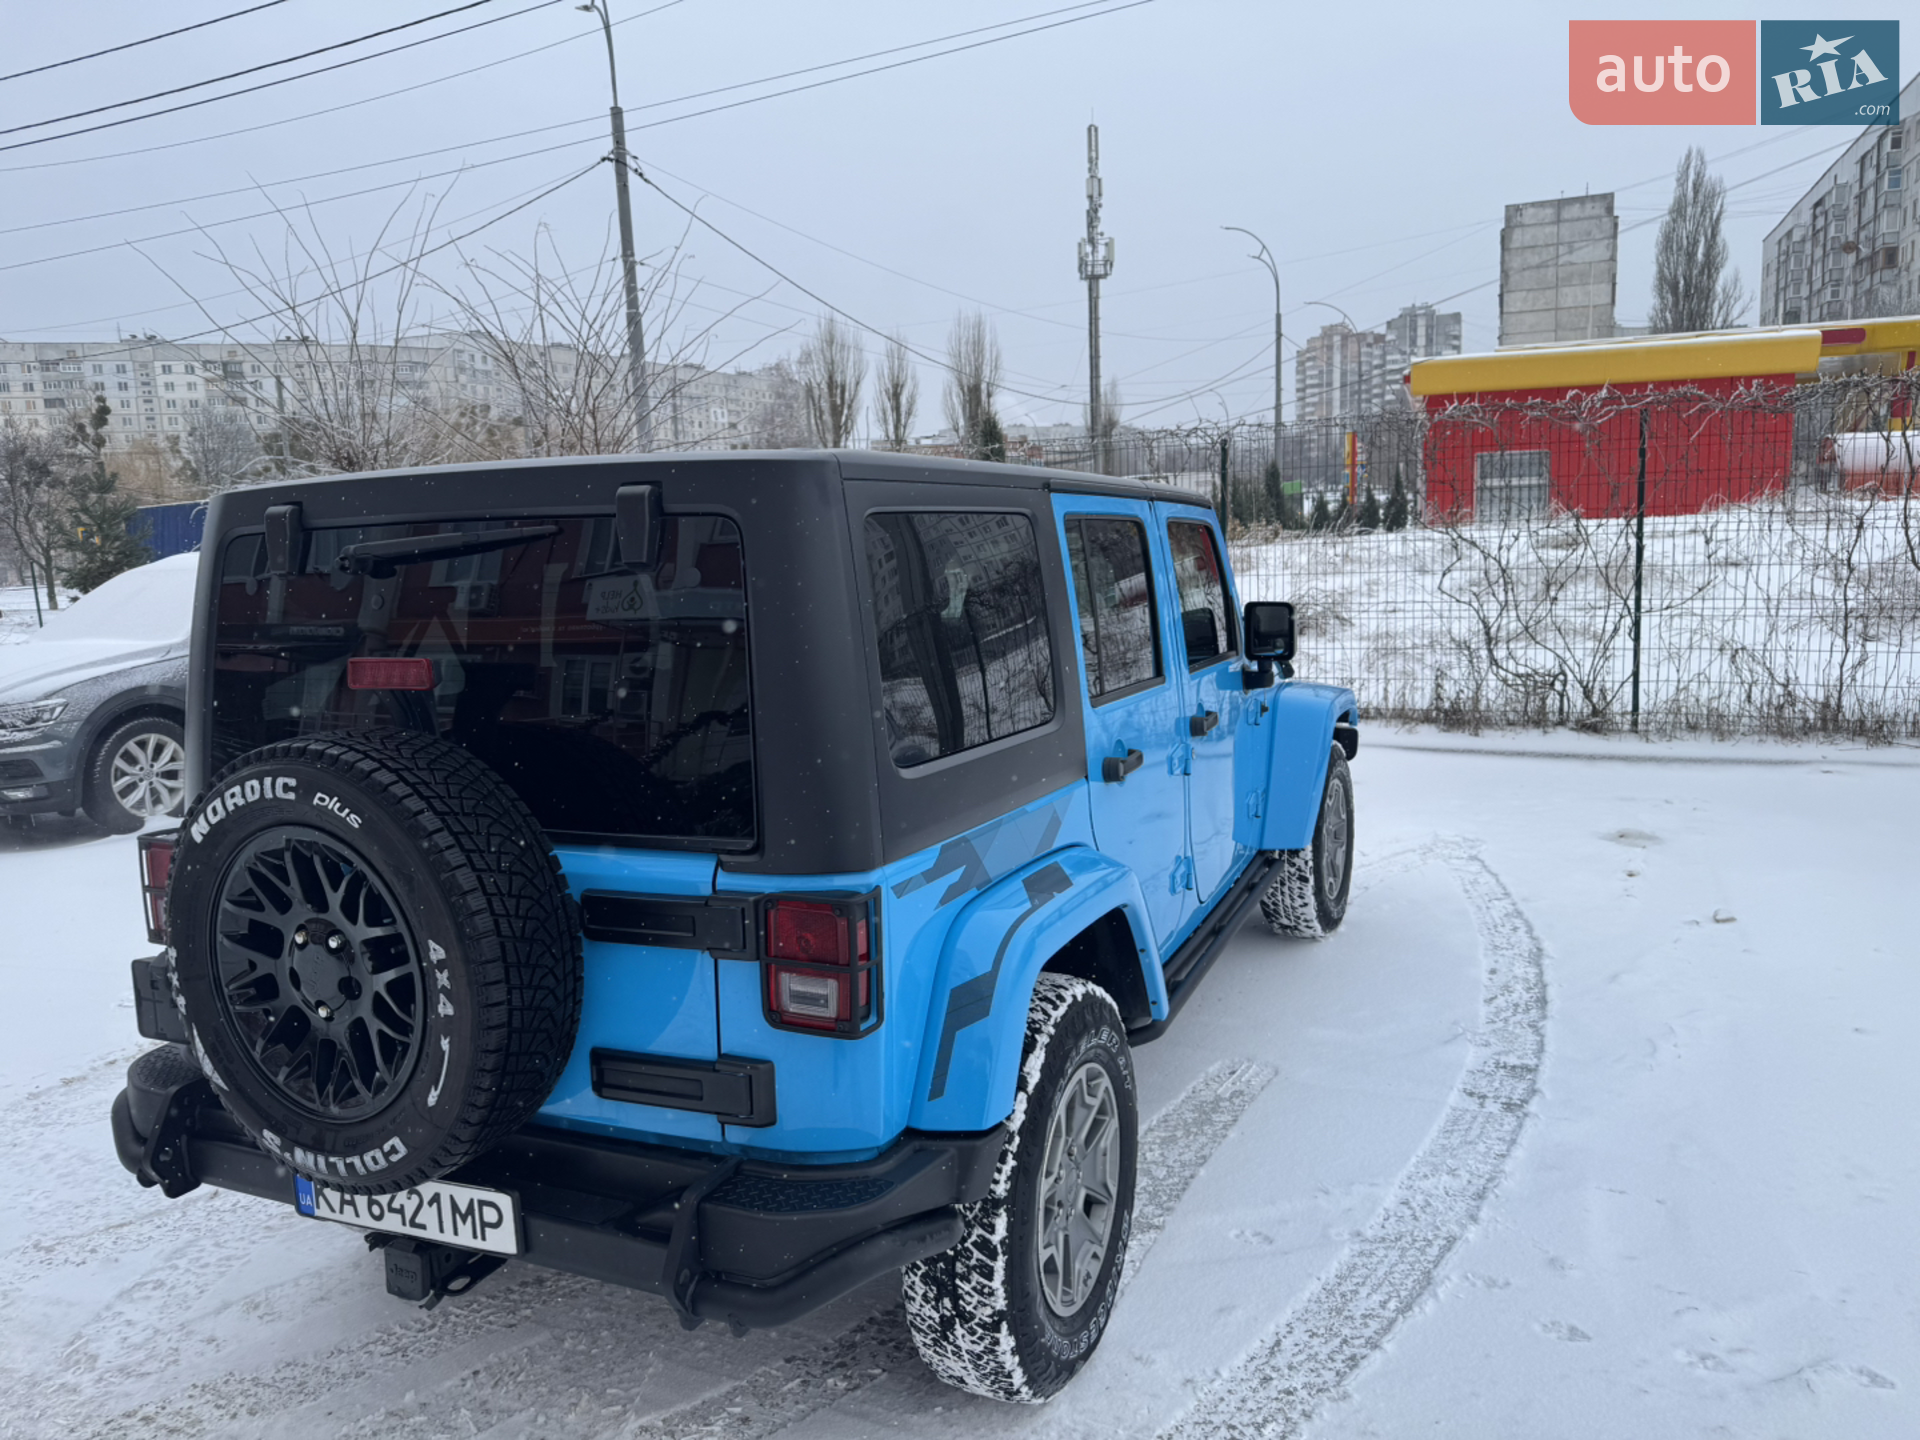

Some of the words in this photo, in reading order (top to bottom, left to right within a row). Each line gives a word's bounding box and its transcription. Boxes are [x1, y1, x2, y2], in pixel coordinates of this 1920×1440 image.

[190, 776, 298, 844] NORDIC
[312, 791, 363, 829] plus
[299, 1193, 313, 1207] UA
